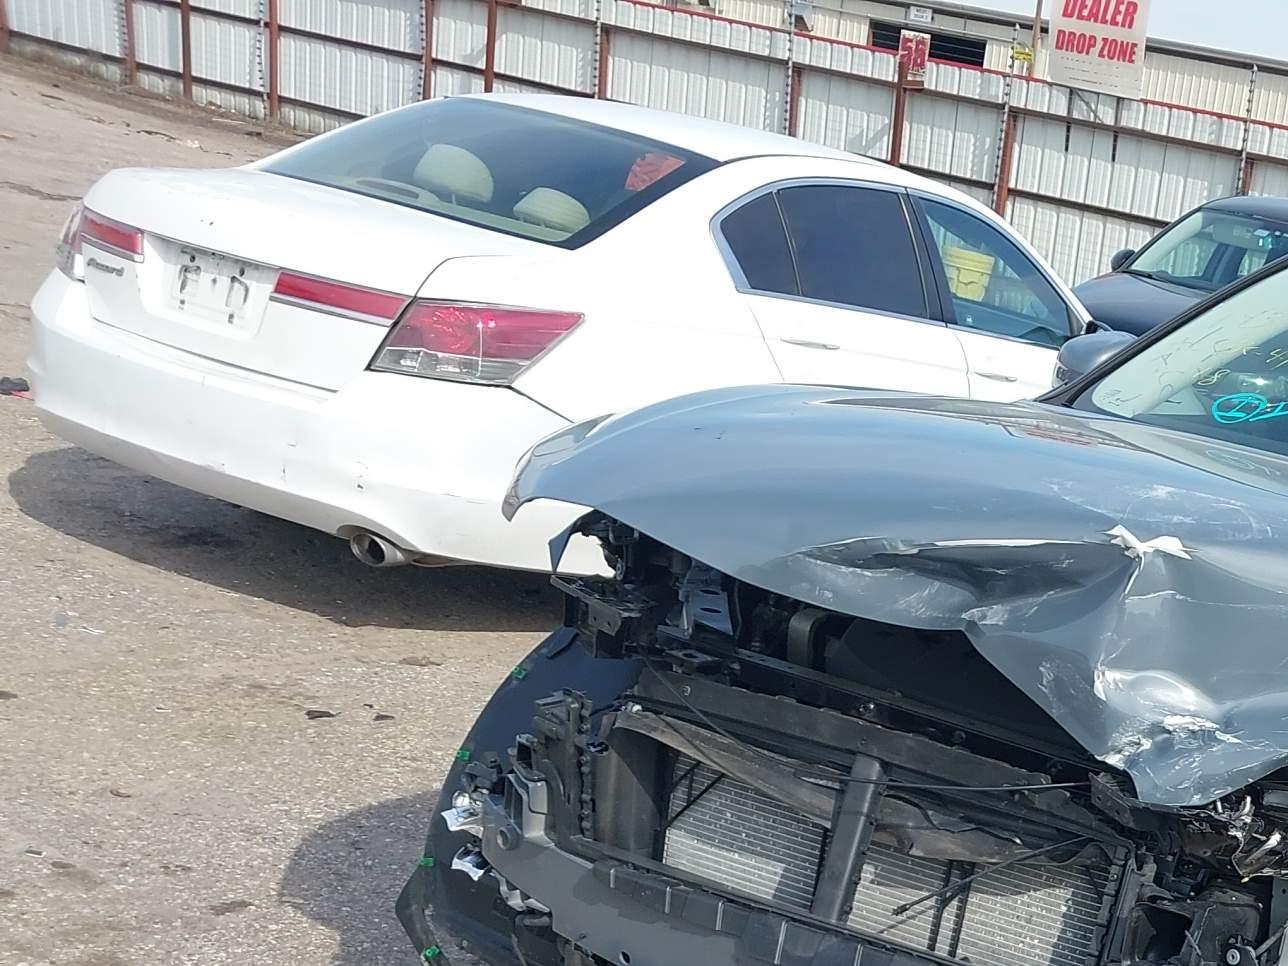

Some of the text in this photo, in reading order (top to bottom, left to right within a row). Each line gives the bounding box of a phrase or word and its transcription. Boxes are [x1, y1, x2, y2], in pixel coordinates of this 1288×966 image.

[1062, 0, 1138, 29] DEALER
[1055, 29, 1097, 56] DROP
[1097, 37, 1138, 64] ZONE
